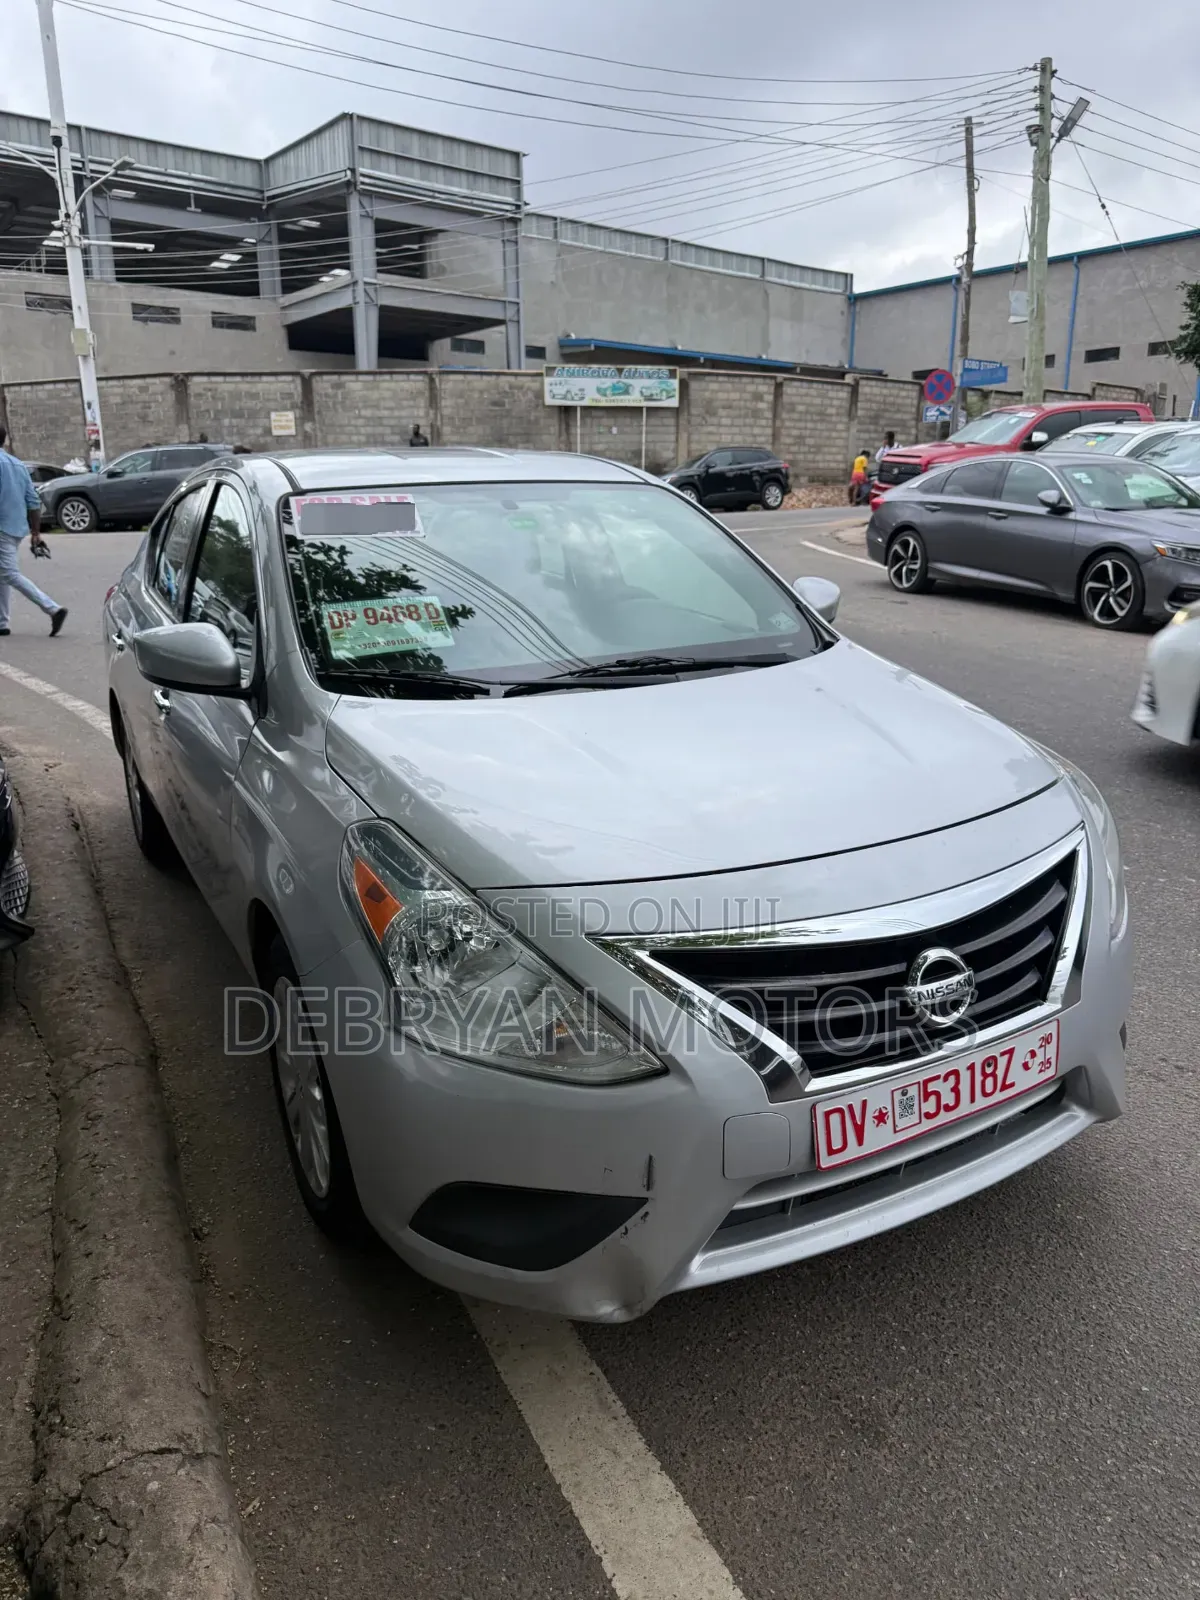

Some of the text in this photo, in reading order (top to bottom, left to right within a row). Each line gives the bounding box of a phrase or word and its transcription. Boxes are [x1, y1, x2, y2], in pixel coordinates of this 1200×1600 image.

[363, 604, 422, 626] 9468
[917, 974, 973, 1002] NISSAN
[1038, 1032, 1053, 1049] 20
[1037, 1057, 1052, 1074] 25
[824, 1046, 1016, 1157] DV 5318Z
